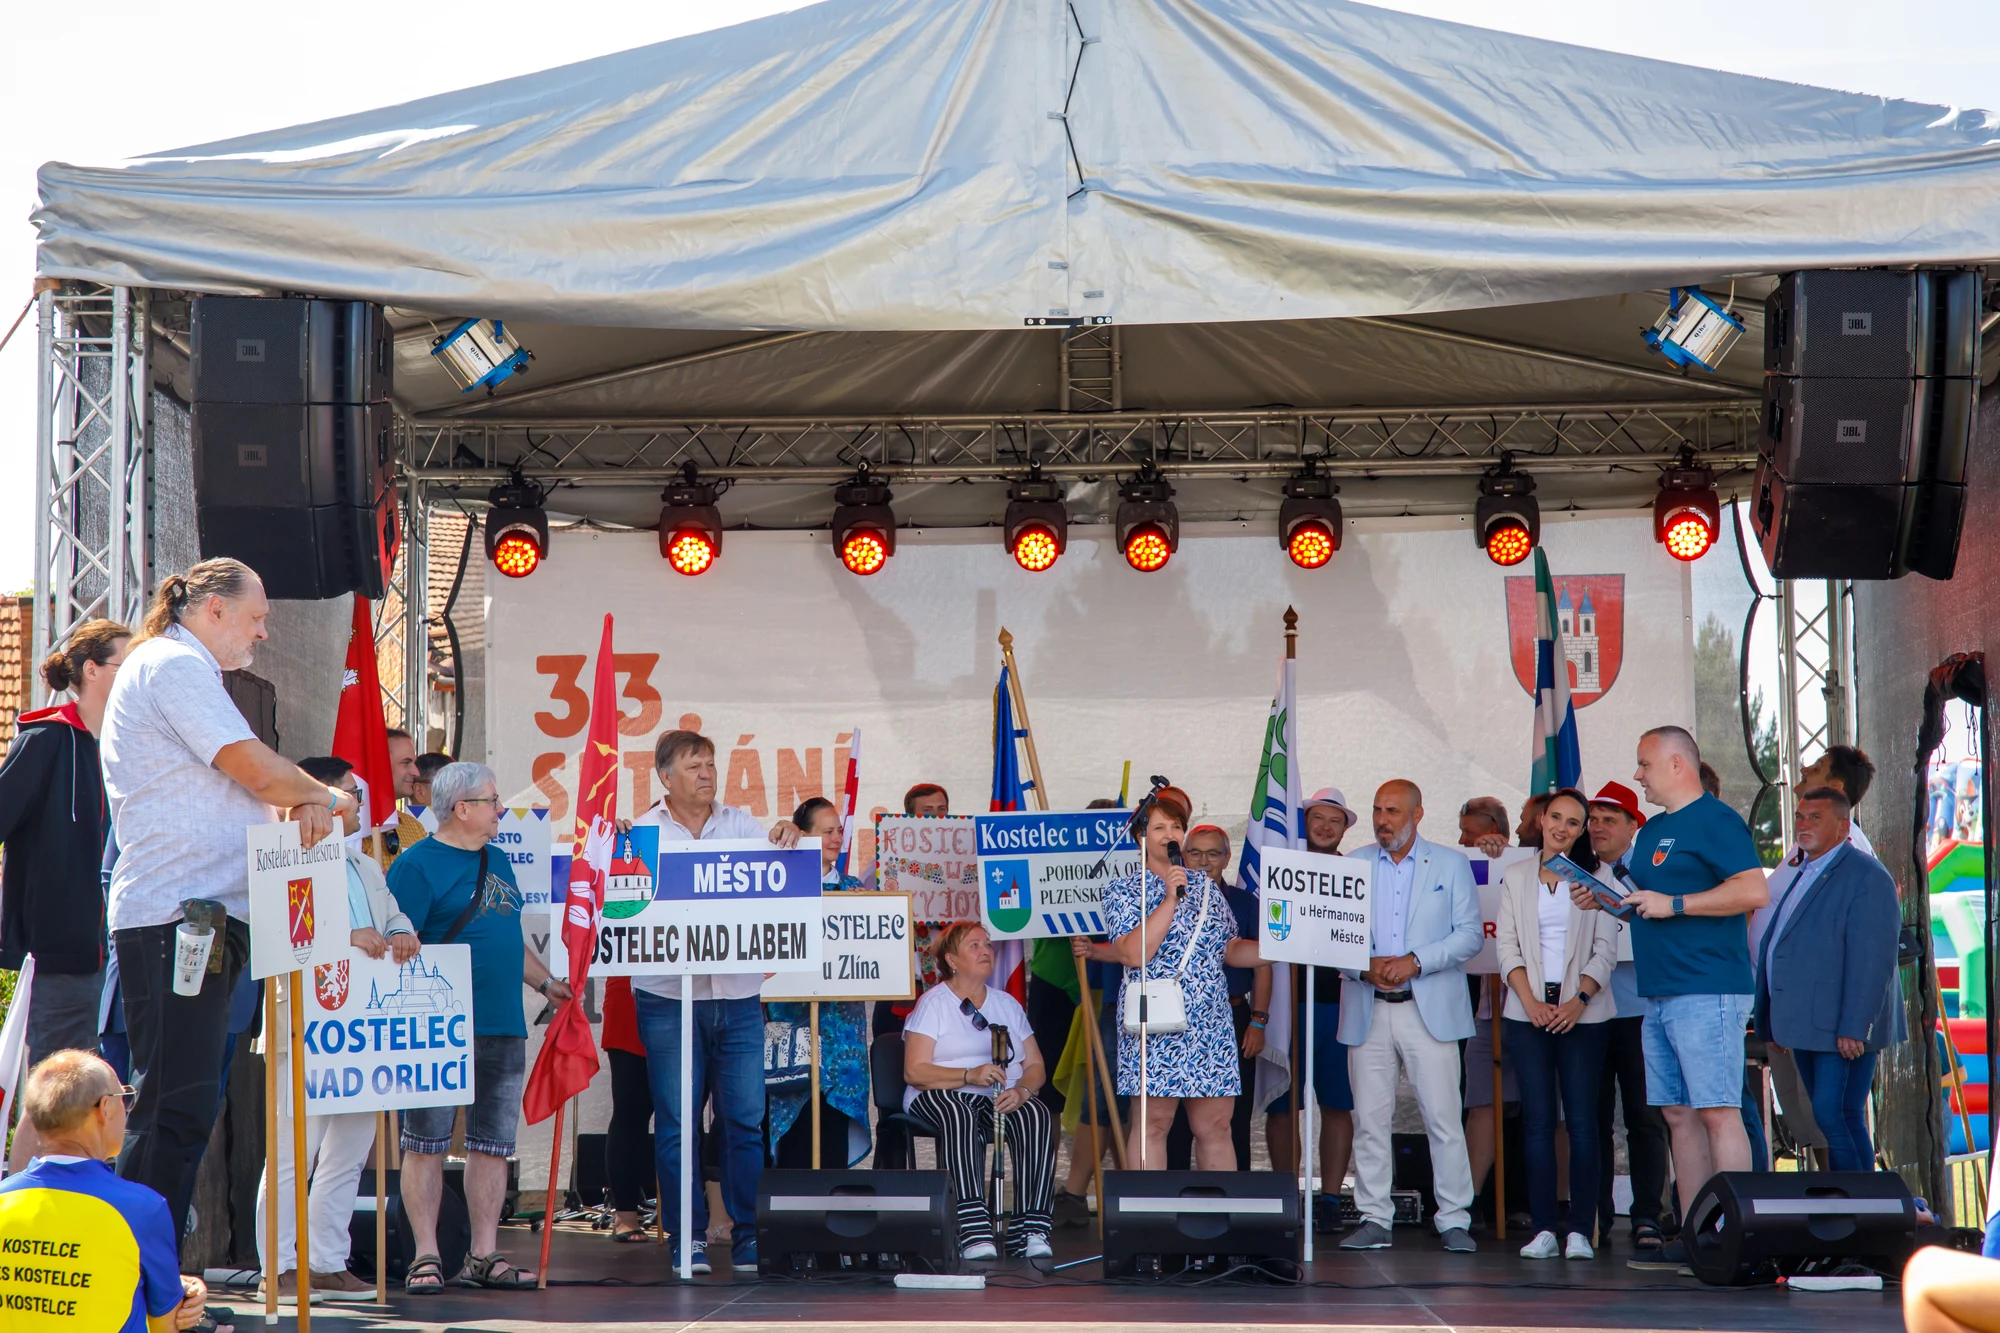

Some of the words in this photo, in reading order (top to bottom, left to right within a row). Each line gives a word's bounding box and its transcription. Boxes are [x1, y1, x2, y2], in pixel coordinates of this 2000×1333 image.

[1848, 319, 1866, 329] JBL
[242, 345, 260, 356] JBL
[1843, 426, 1861, 437] JBL
[244, 450, 262, 461] JBL
[980, 821, 1069, 849] Kostelec
[1075, 826, 1088, 845] u
[256, 834, 291, 872] Kostelec
[693, 854, 787, 893] MĚSTO
[1267, 865, 1366, 900] KOSTELEC
[1300, 906, 1306, 916] u
[1309, 904, 1365, 923] Heřmanova
[687, 923, 730, 962] NAD
[736, 922, 807, 961] LABEM
[1330, 928, 1365, 945] Městce
[823, 961, 832, 980] u
[838, 954, 880, 980] Zlína
[304, 1014, 467, 1055] KOSTELEC
[371, 1053, 469, 1095] ORLICÍ
[2, 1238, 81, 1259] KOSTELCE
[14, 1266, 92, 1288] KOSTELCE
[6, 1294, 77, 1316] KOSTELCE
